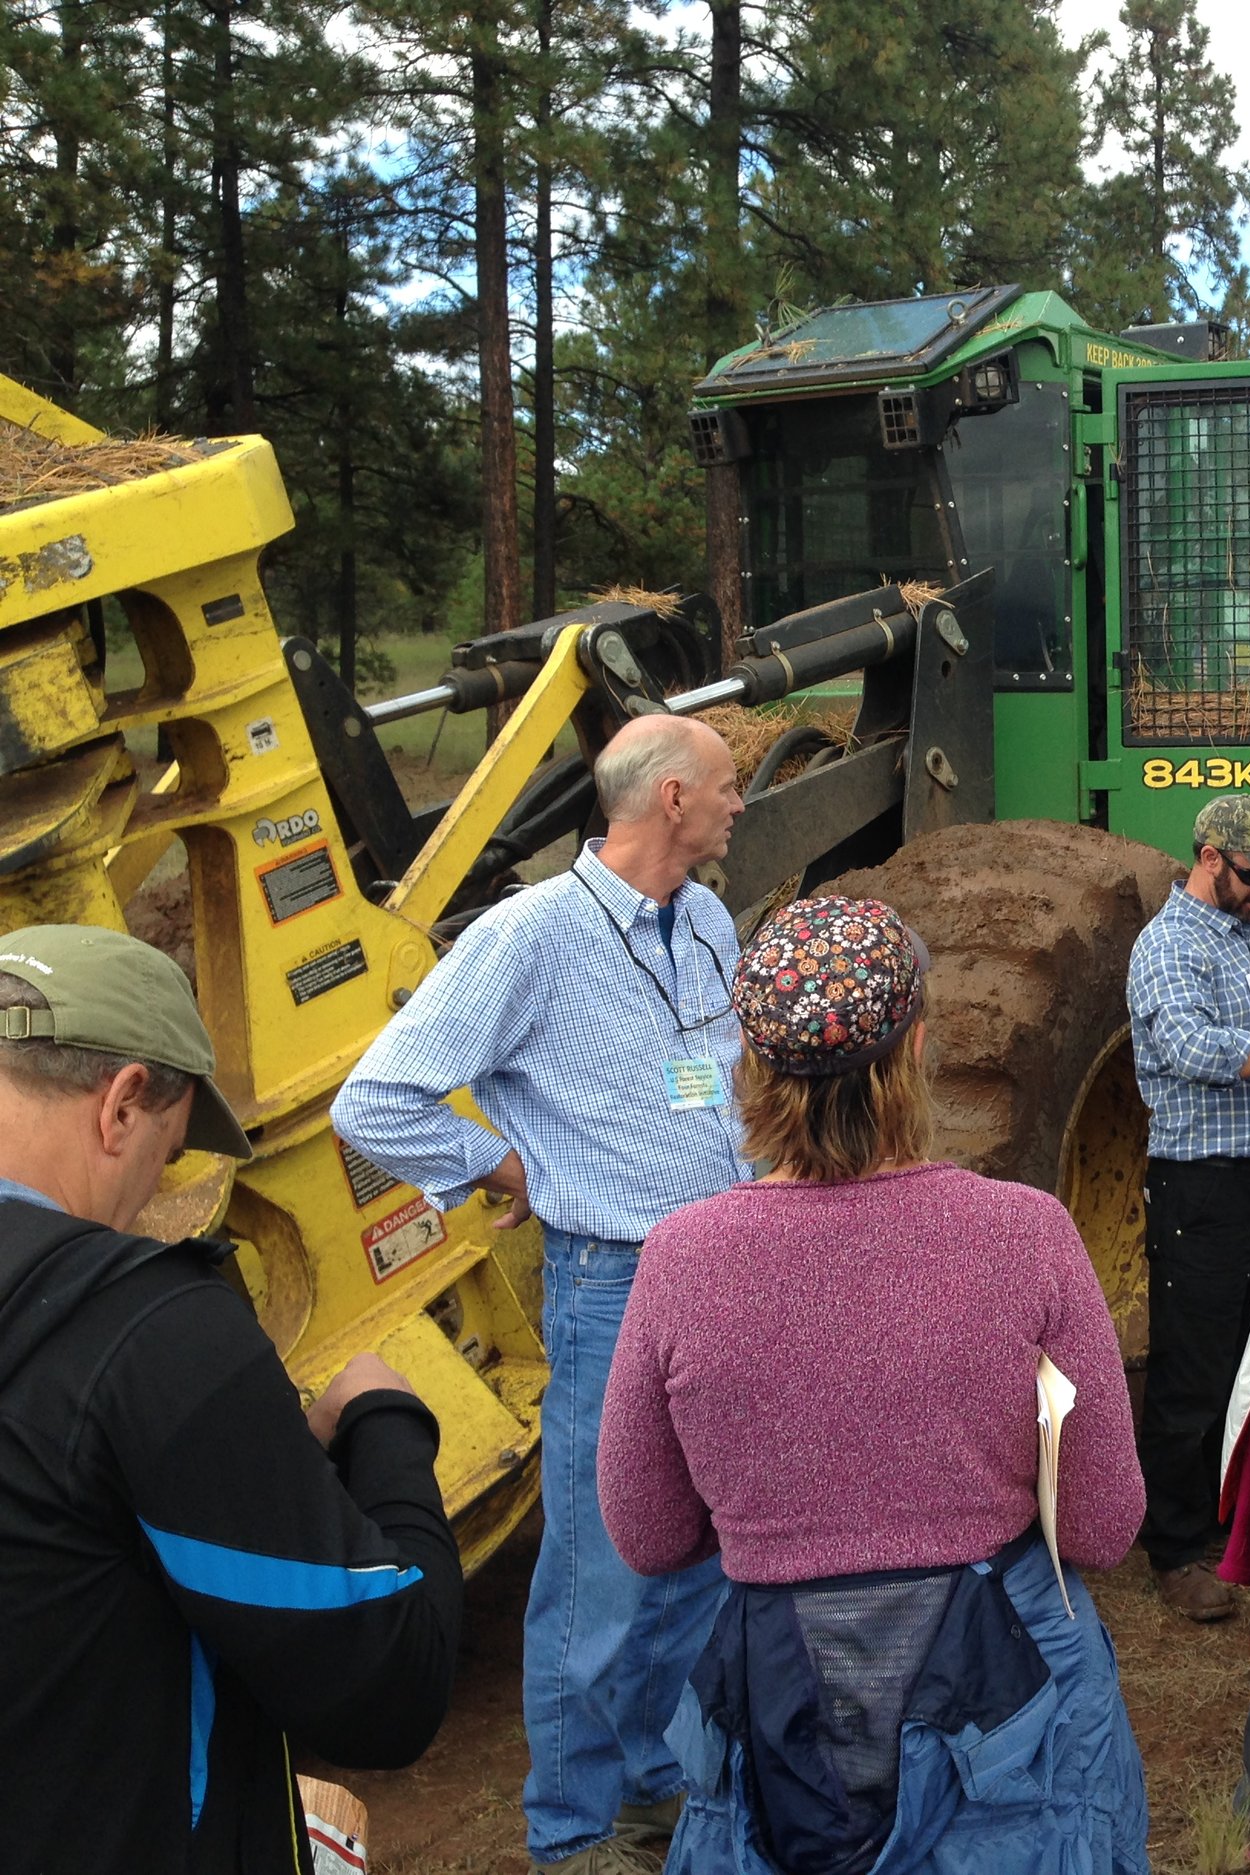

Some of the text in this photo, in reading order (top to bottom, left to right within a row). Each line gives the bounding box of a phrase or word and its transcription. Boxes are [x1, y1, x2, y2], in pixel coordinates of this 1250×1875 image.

[1087, 343, 1109, 366] KEEP
[1112, 350, 1135, 368] BACK
[309, 938, 342, 958] CAUTION
[666, 1064, 712, 1074] SCOTT RUSSELL
